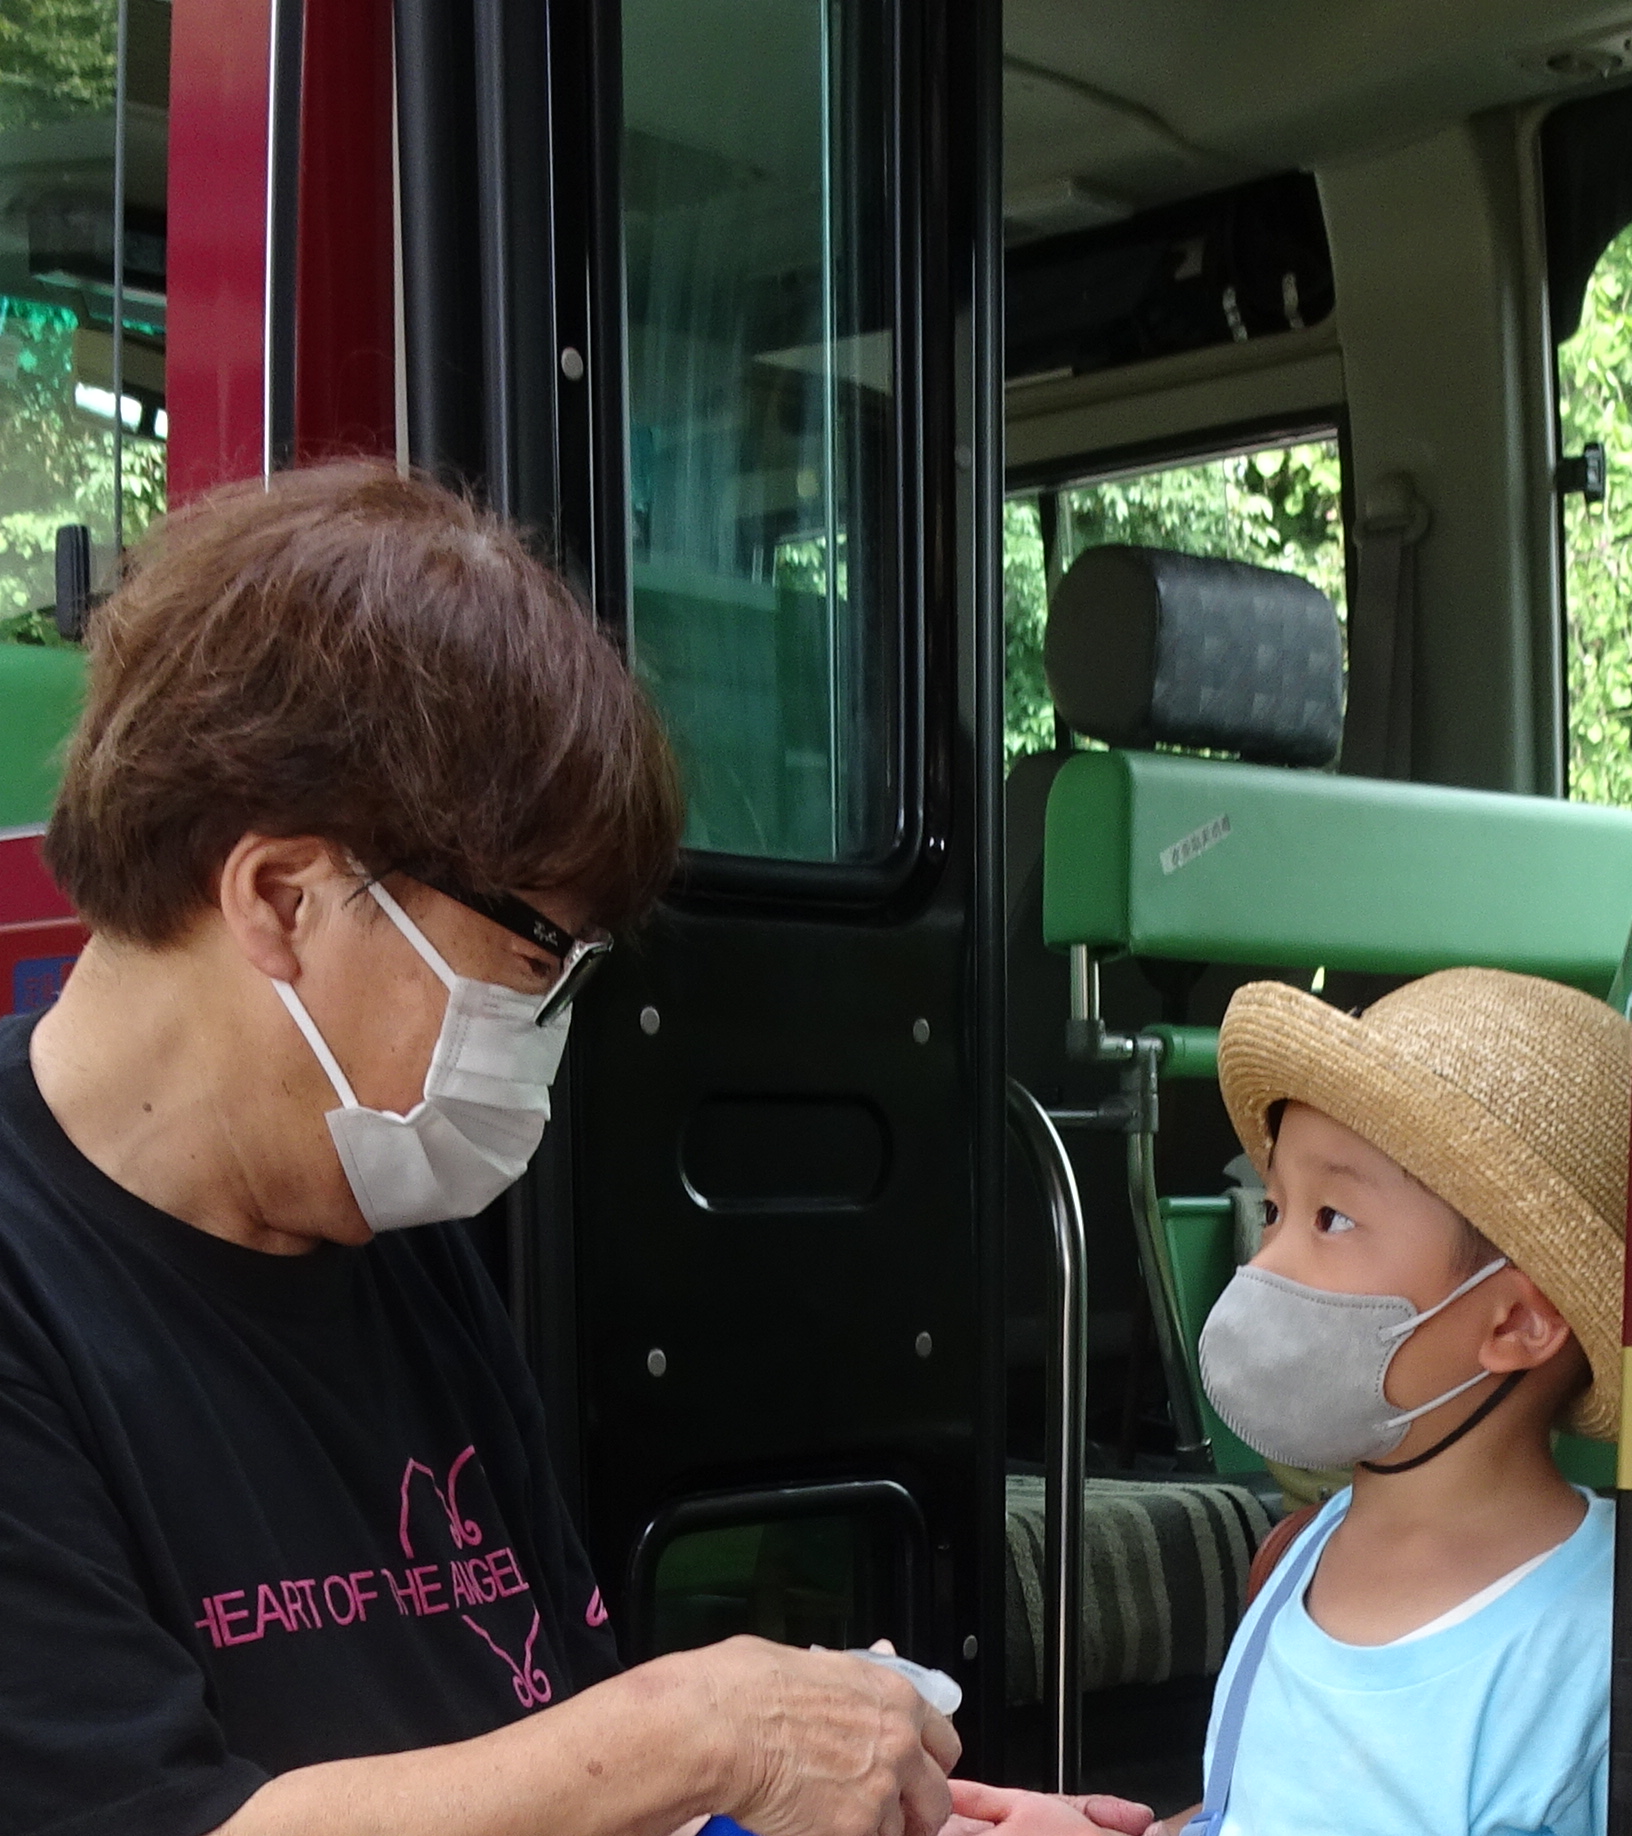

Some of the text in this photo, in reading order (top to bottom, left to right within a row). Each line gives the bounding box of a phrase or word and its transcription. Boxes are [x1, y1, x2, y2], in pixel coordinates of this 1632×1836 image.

[194, 1579, 322, 1649] HEART
[323, 1571, 378, 1626] OF
[380, 1564, 450, 1617] THE
